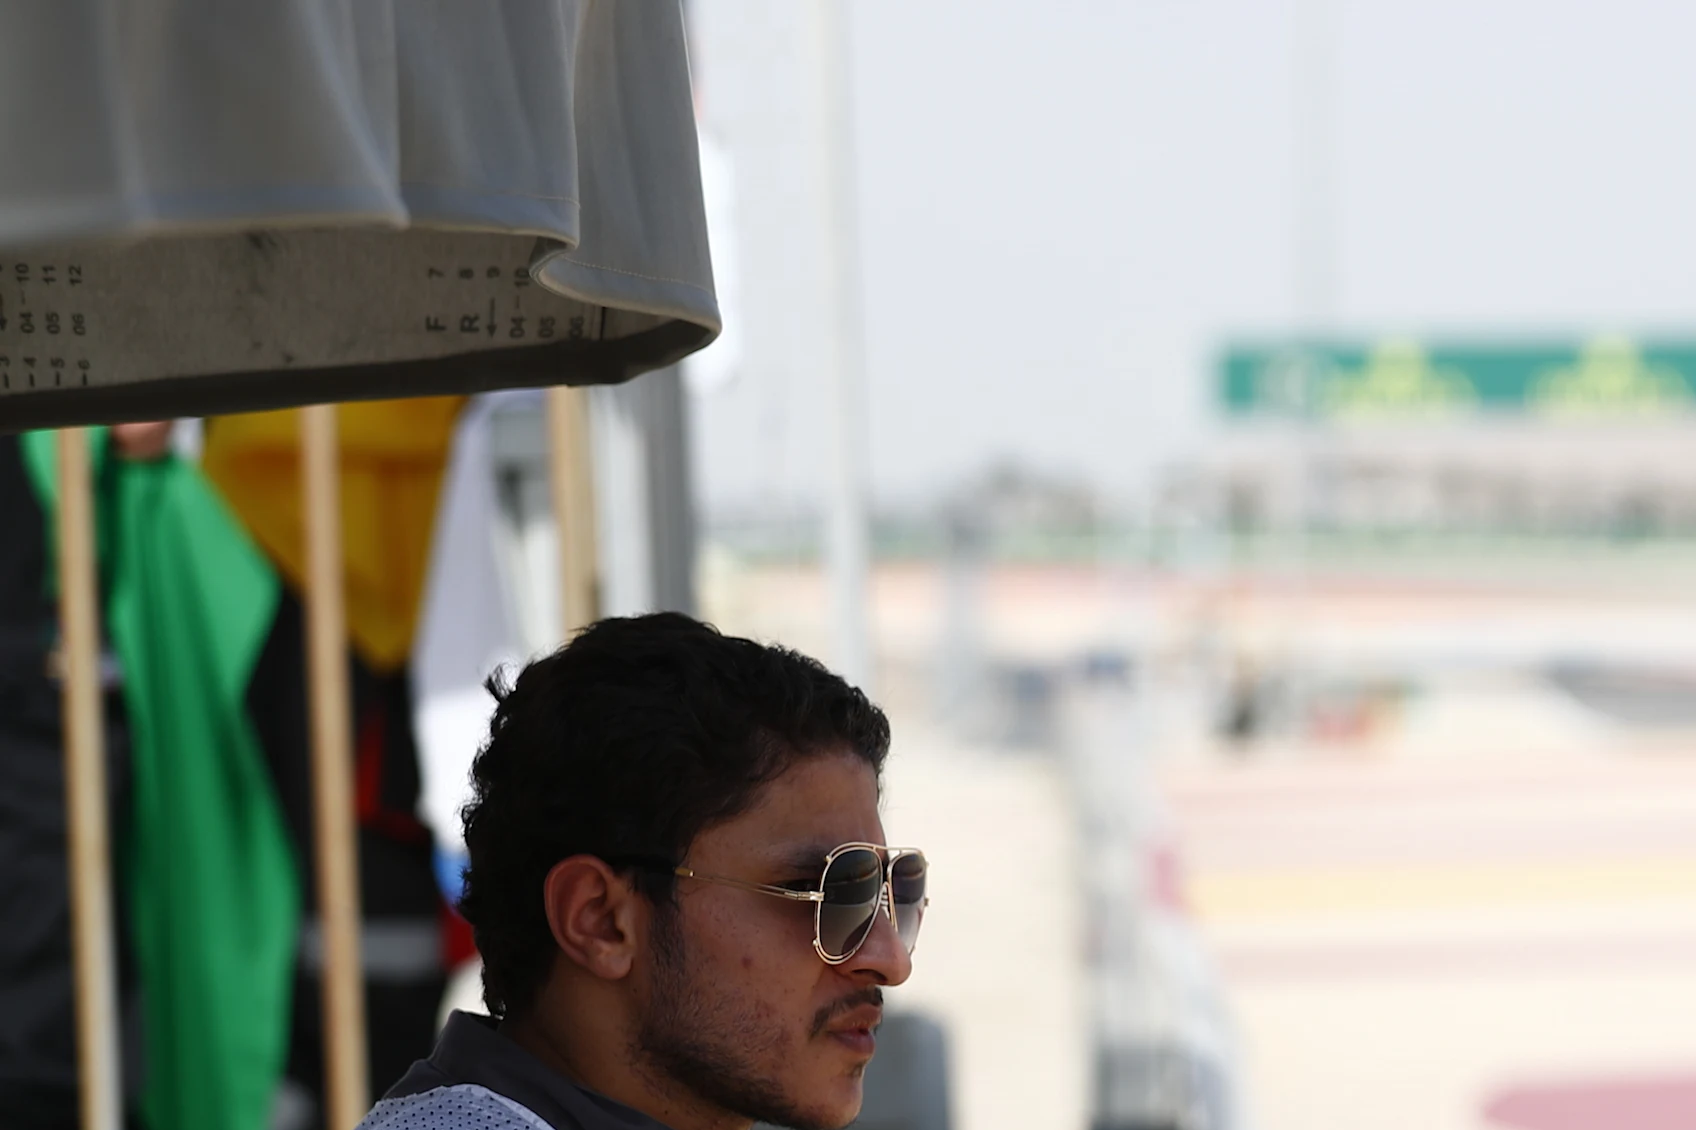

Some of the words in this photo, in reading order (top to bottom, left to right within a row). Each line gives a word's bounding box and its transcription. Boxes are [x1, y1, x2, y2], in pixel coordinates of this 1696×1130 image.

[15, 262, 29, 282] 10
[42, 265, 56, 285] 11
[69, 264, 82, 286] 12
[428, 266, 445, 279] 7
[513, 266, 530, 288] 10
[20, 311, 35, 334] 04
[45, 311, 60, 334] 05
[71, 313, 85, 335] 06
[425, 314, 447, 332] F
[459, 313, 480, 333] R
[509, 315, 526, 338] 04
[538, 315, 556, 338] 05
[23, 357, 37, 369] 4
